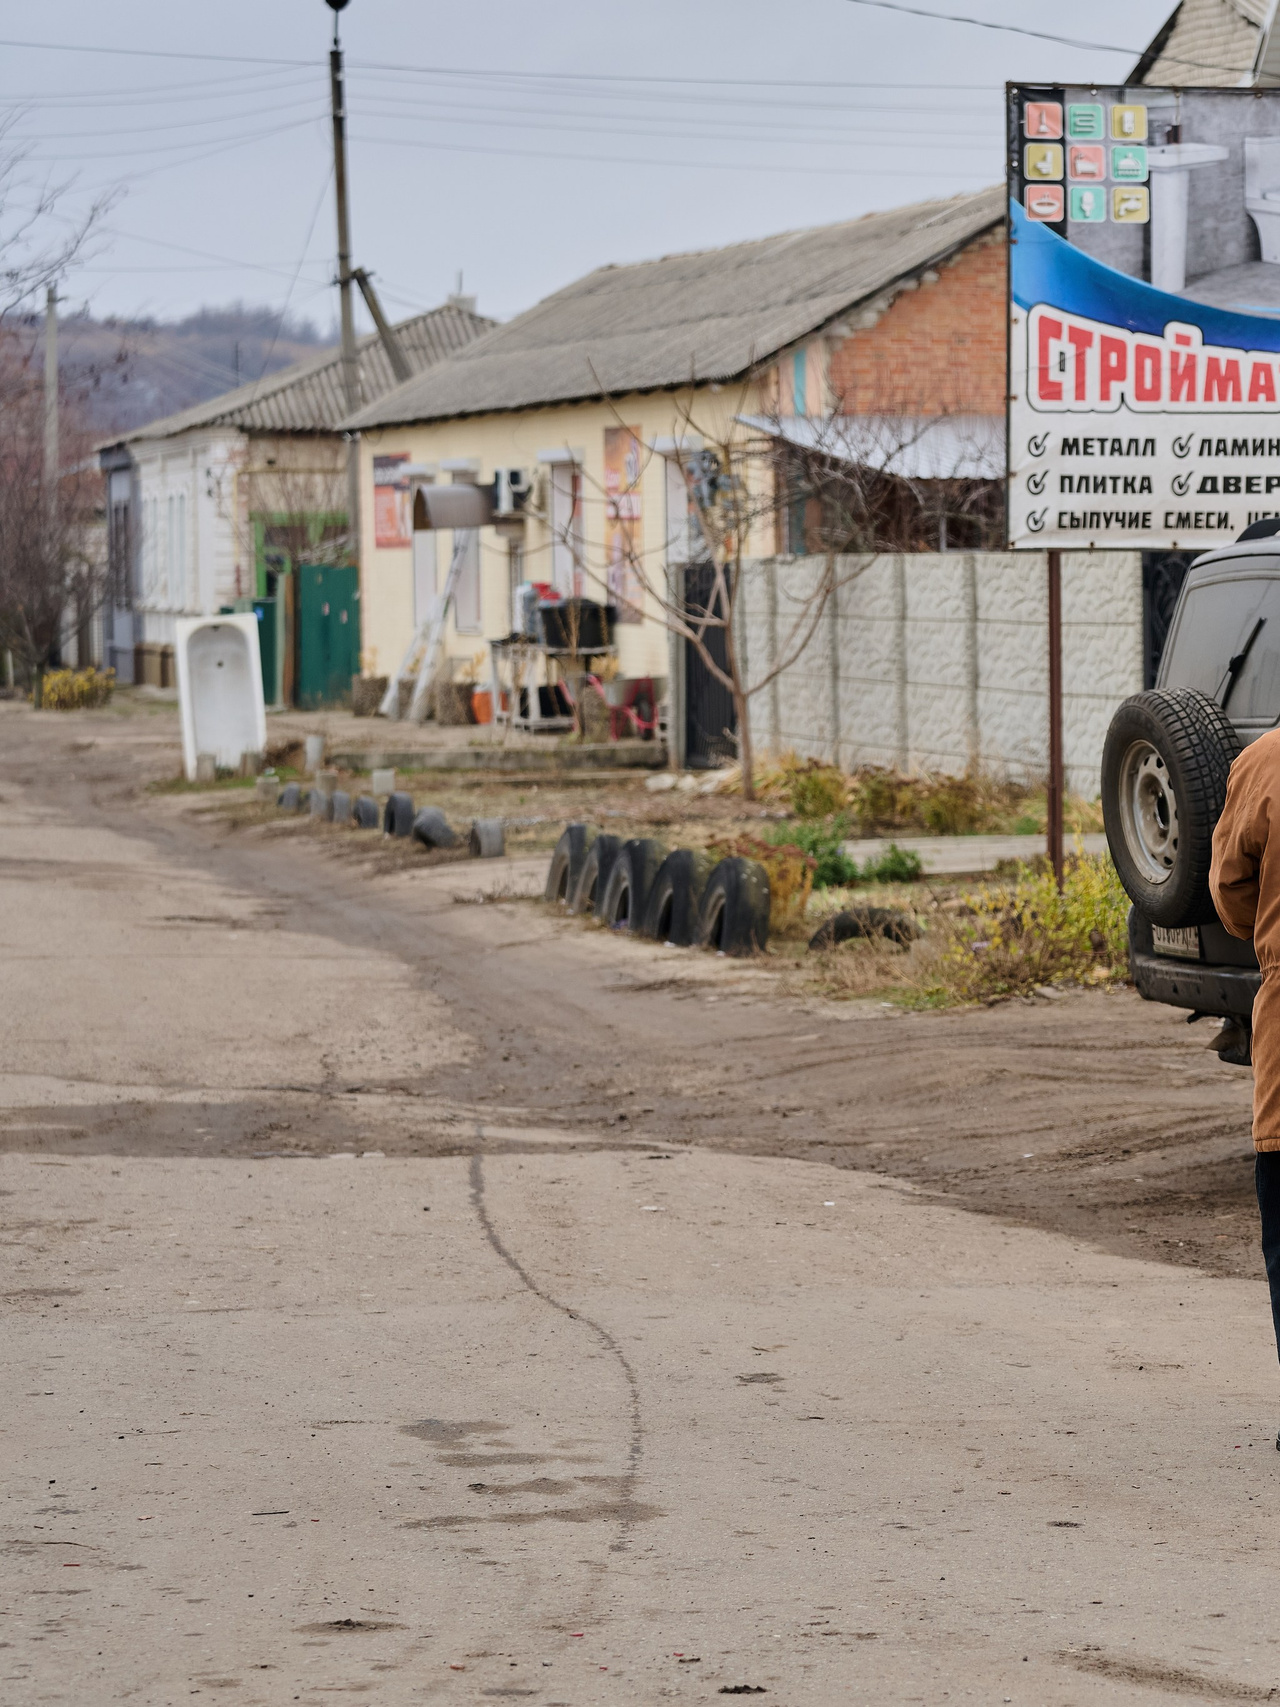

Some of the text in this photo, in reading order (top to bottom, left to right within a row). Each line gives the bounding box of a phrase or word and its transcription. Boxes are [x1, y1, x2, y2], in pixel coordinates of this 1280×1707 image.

[1060, 438, 1156, 456] МЕТАЛЛ
[1059, 475, 1153, 494] ПЛИТКА
[1057, 511, 1152, 529] СЫПУЧИЕ
[1164, 511, 1235, 531] СМЕСИ,
